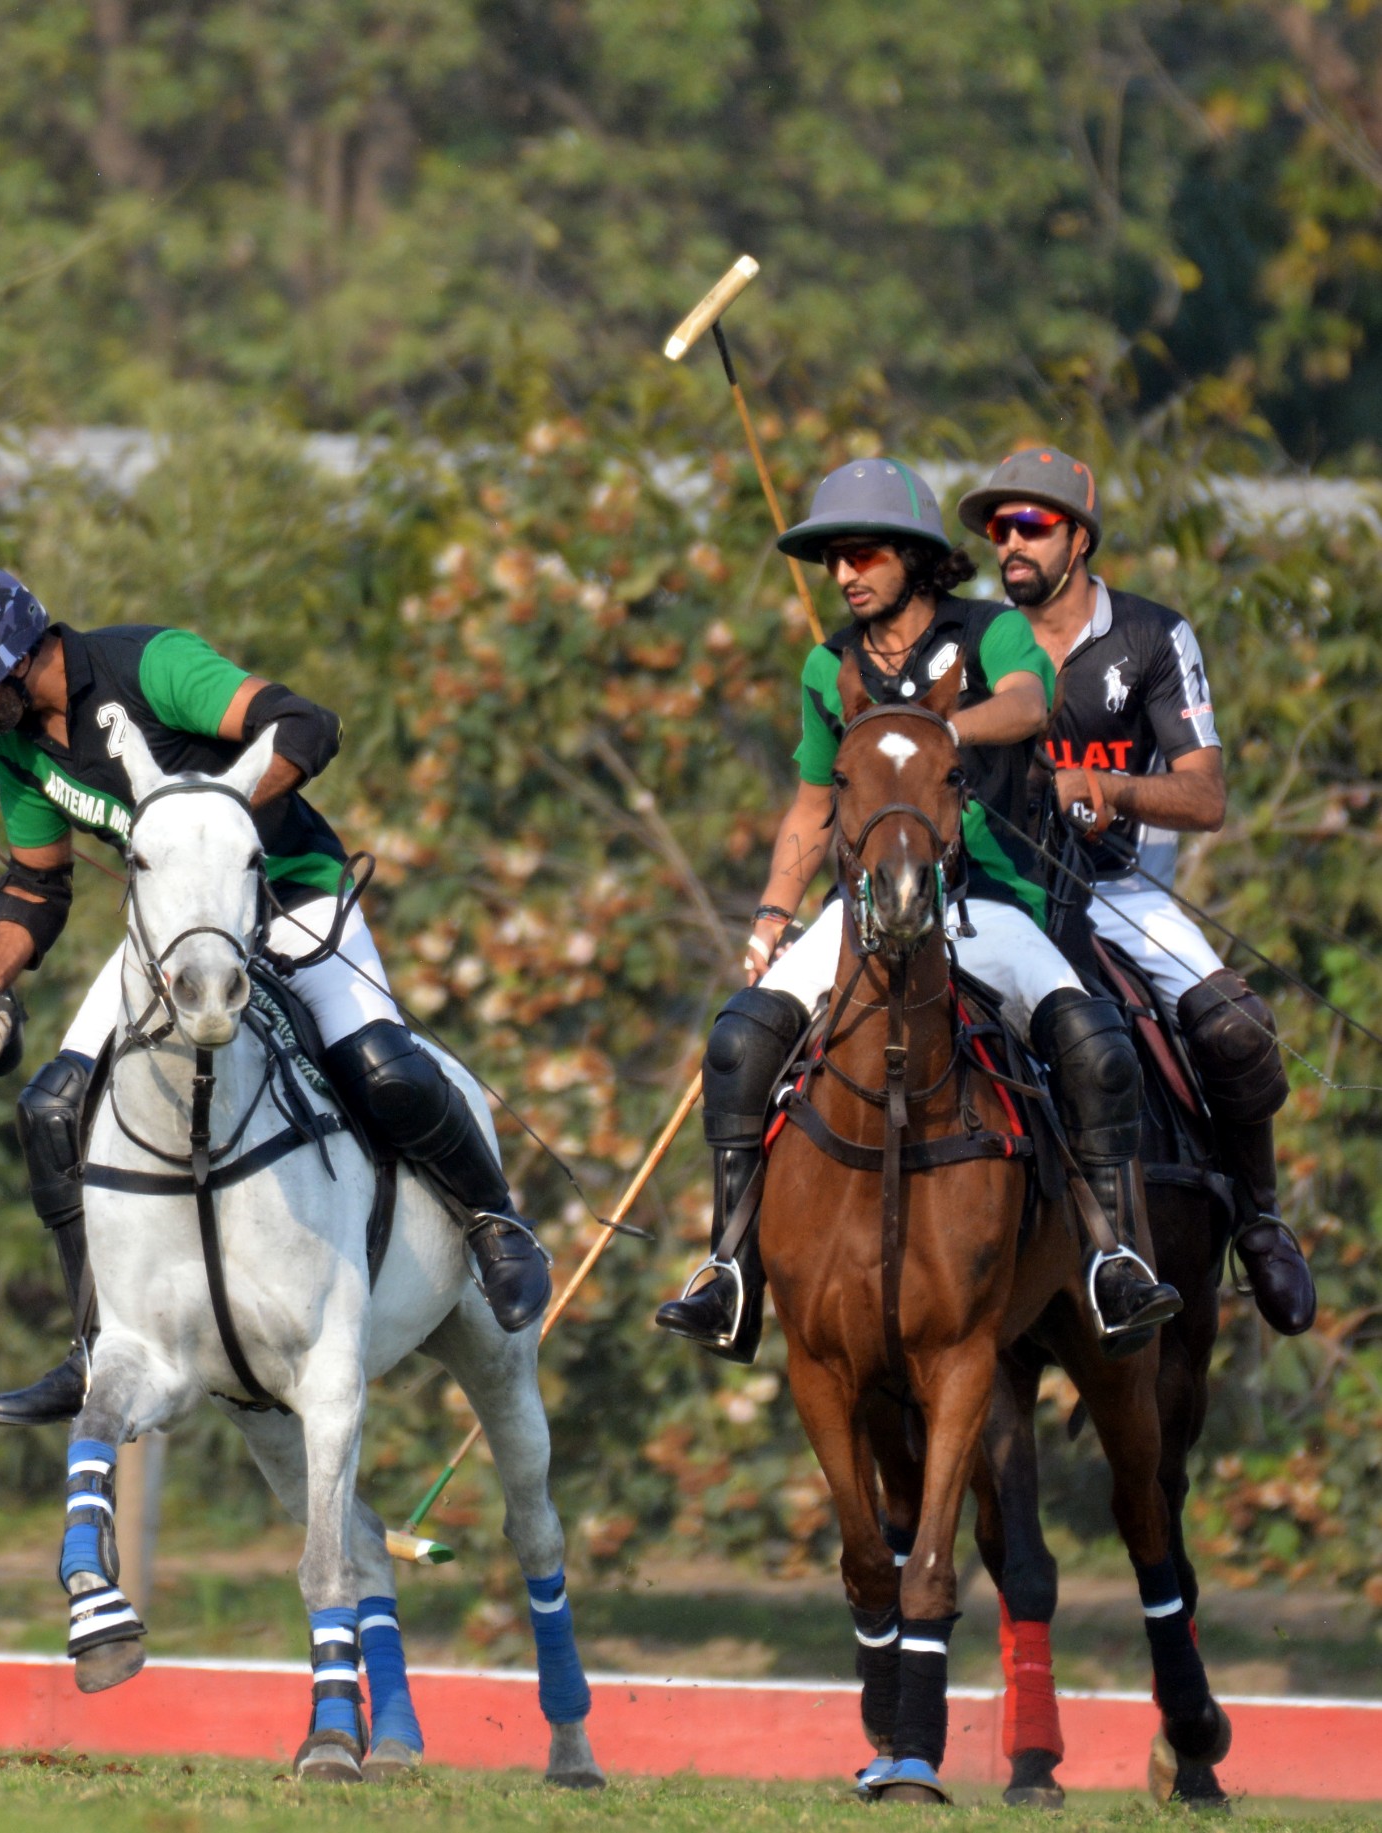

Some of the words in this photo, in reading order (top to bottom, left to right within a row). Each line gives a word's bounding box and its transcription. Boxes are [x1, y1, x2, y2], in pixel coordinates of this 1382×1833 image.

[97, 702, 129, 759] 2
[1045, 739, 1134, 770] LLAT
[44, 770, 106, 826] ARTEMA
